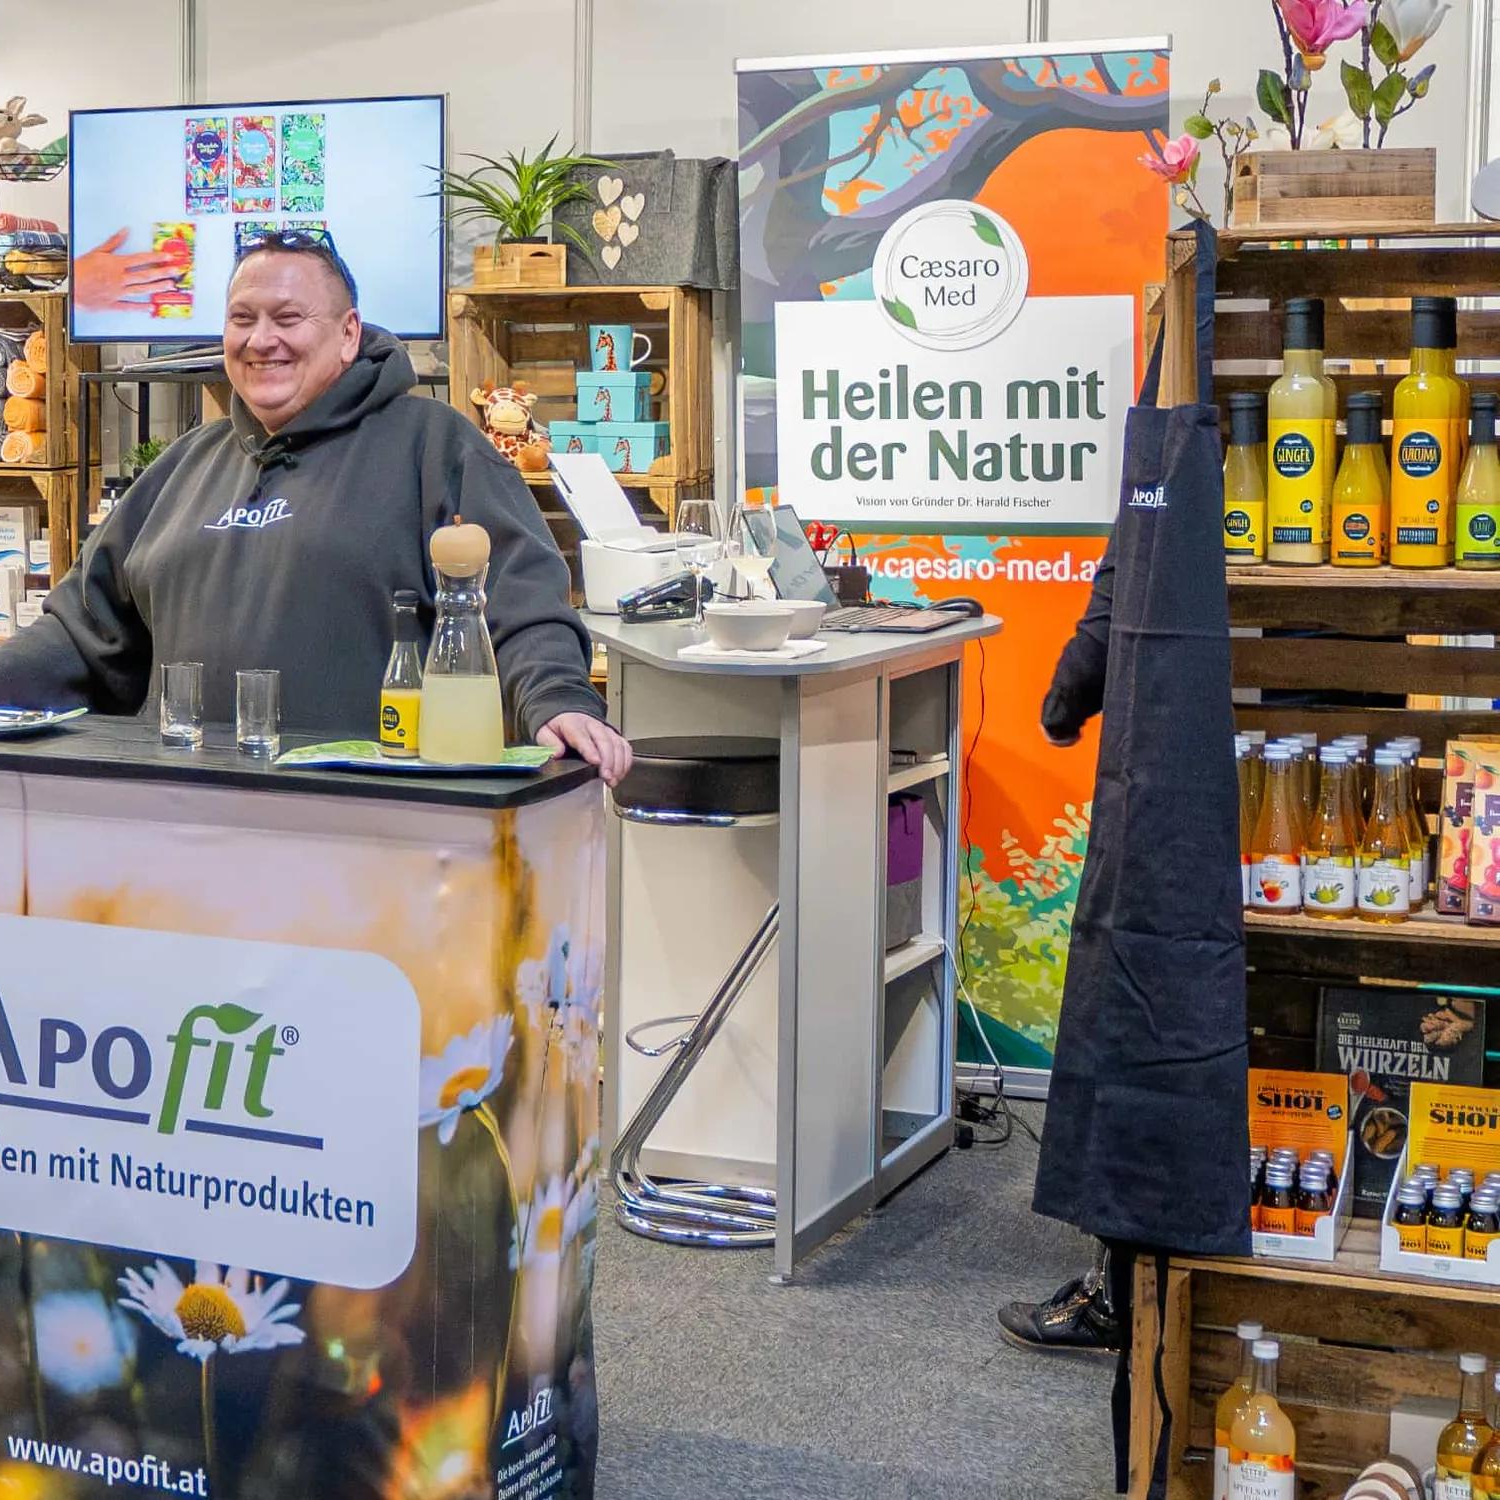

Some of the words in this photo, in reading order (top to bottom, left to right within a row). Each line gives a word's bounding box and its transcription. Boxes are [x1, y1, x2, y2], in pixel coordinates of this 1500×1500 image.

[900, 254, 1000, 279] Cæsaro
[924, 285, 976, 307] Med
[802, 364, 982, 421] Heilen
[1006, 366, 1106, 420] mit
[811, 425, 906, 481] der
[928, 430, 1097, 481] Natur
[856, 496, 887, 507] Vision
[890, 498, 908, 507] von
[911, 496, 955, 509] Gründer
[957, 496, 973, 507] Dr.
[976, 496, 1010, 508] Harald
[1013, 497, 1051, 508] Fischer
[1338, 1034, 1353, 1046] DIE
[1356, 1036, 1409, 1052] HEILKRAFT
[1338, 1046, 1450, 1080] WURZELN
[1257, 1092, 1327, 1110] SHOT
[1430, 1109, 1500, 1129] SHOT
[48, 1147, 100, 1184] mit
[110, 1152, 376, 1227] Naturprodukten
[7, 1434, 207, 1497] www.apofit.at
